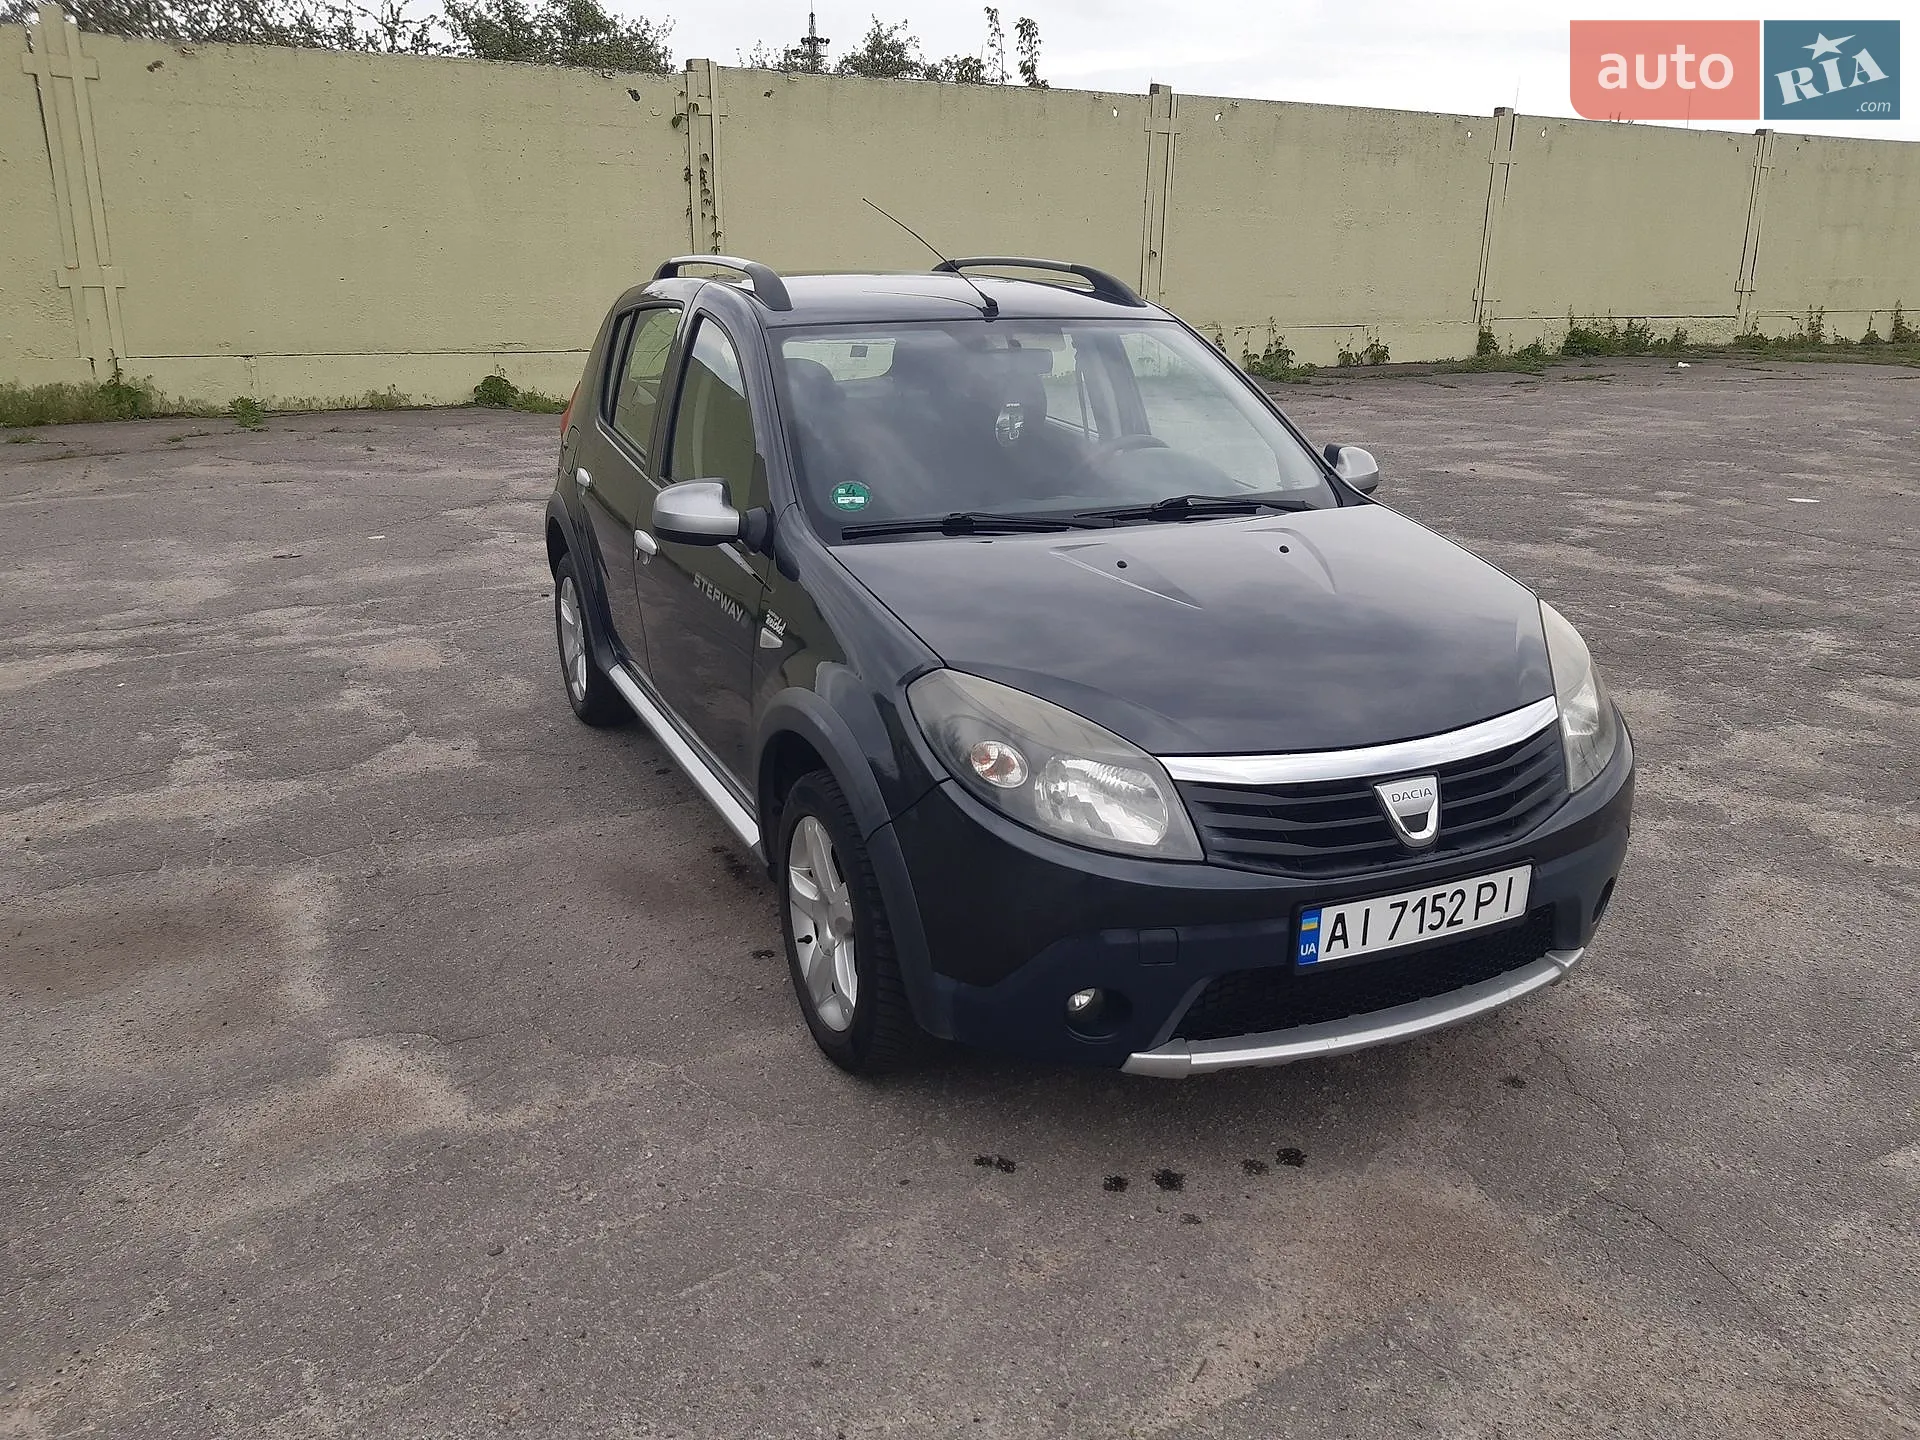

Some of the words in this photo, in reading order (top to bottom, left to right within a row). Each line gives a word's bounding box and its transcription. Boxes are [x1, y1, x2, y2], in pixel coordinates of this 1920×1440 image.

[693, 572, 744, 622] STEPWAY
[1391, 788, 1433, 802] DACIA
[1325, 908, 1370, 954] AI
[1388, 888, 1466, 942] 7152
[1473, 876, 1513, 921] PI
[1300, 943, 1317, 956] UA
